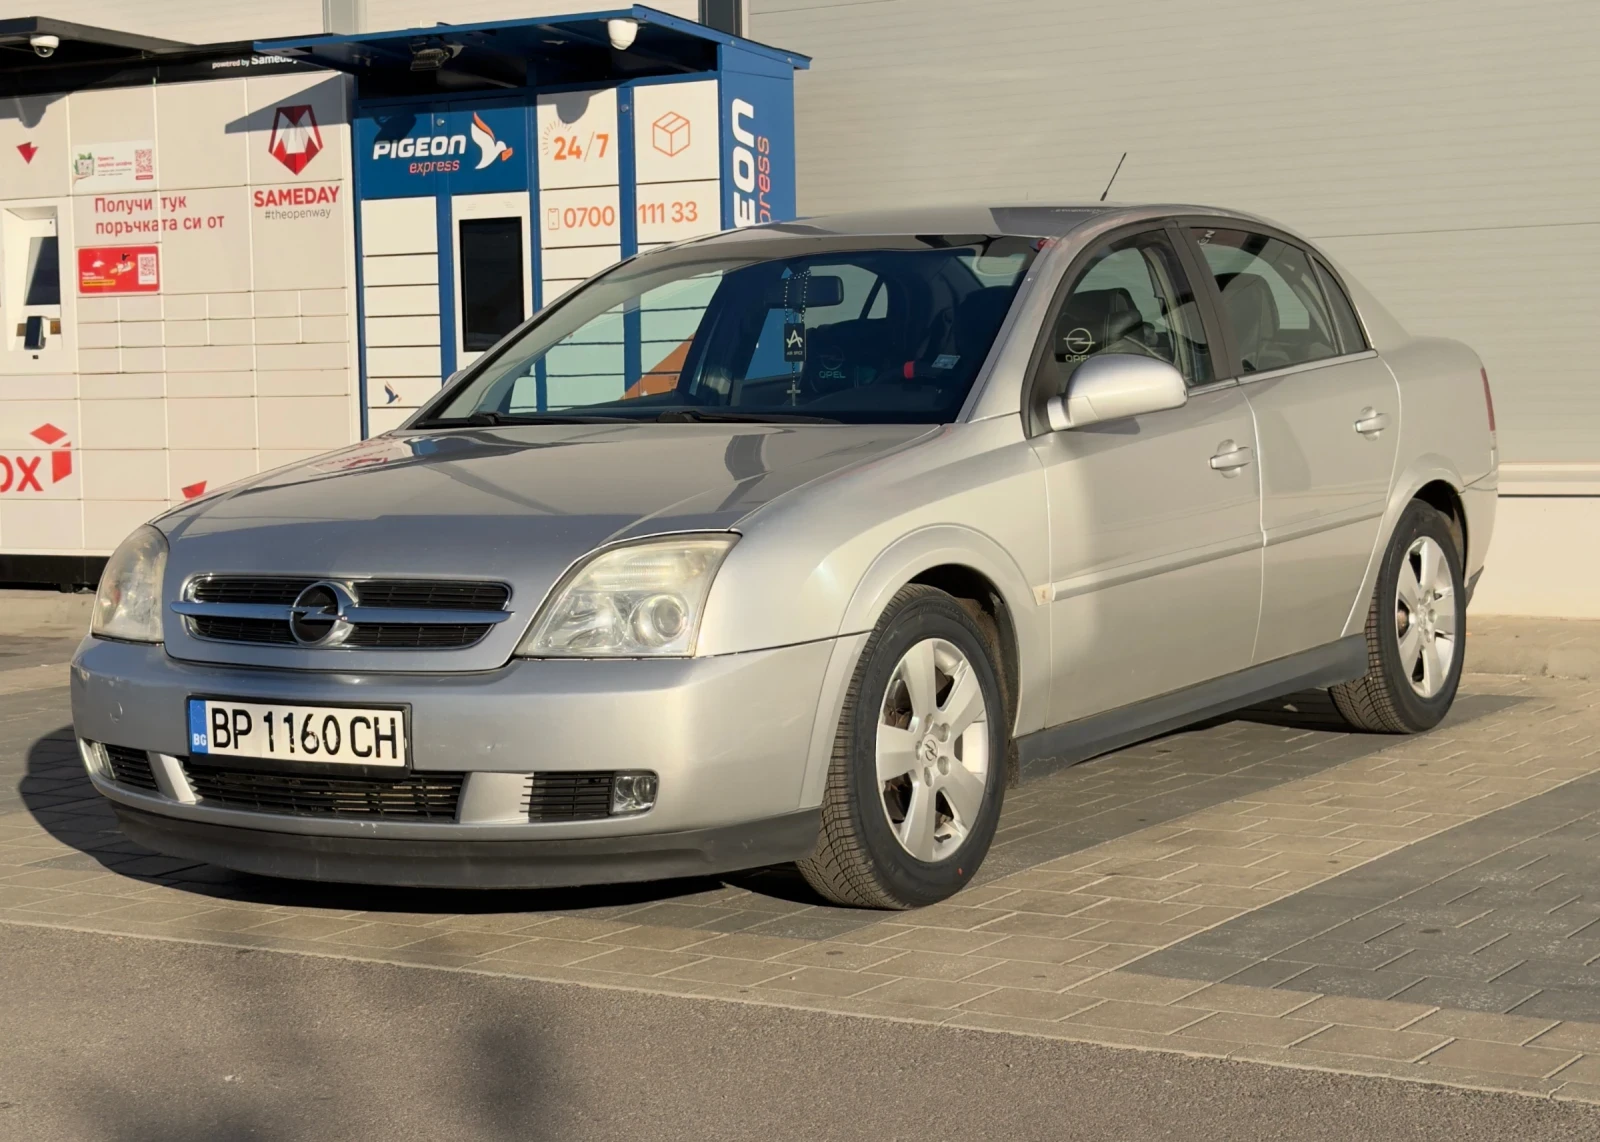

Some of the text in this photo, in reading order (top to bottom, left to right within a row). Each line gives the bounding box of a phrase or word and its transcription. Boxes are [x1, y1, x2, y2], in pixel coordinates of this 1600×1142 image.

[212, 55, 298, 69] powered by Same
[373, 135, 466, 160] PIGEON
[553, 131, 609, 162] 24/7
[409, 160, 460, 176] express
[95, 195, 187, 213] Получи тук
[254, 186, 340, 207] SAMEDAY
[264, 207, 331, 220] #theopenway
[563, 201, 698, 229] 0700 111 33
[96, 215, 225, 236] поръчката си от
[1065, 354, 1090, 363] OPE
[819, 371, 846, 379] OPEL
[193, 733, 206, 746] BG
[211, 707, 397, 759] BP 1160 CH
